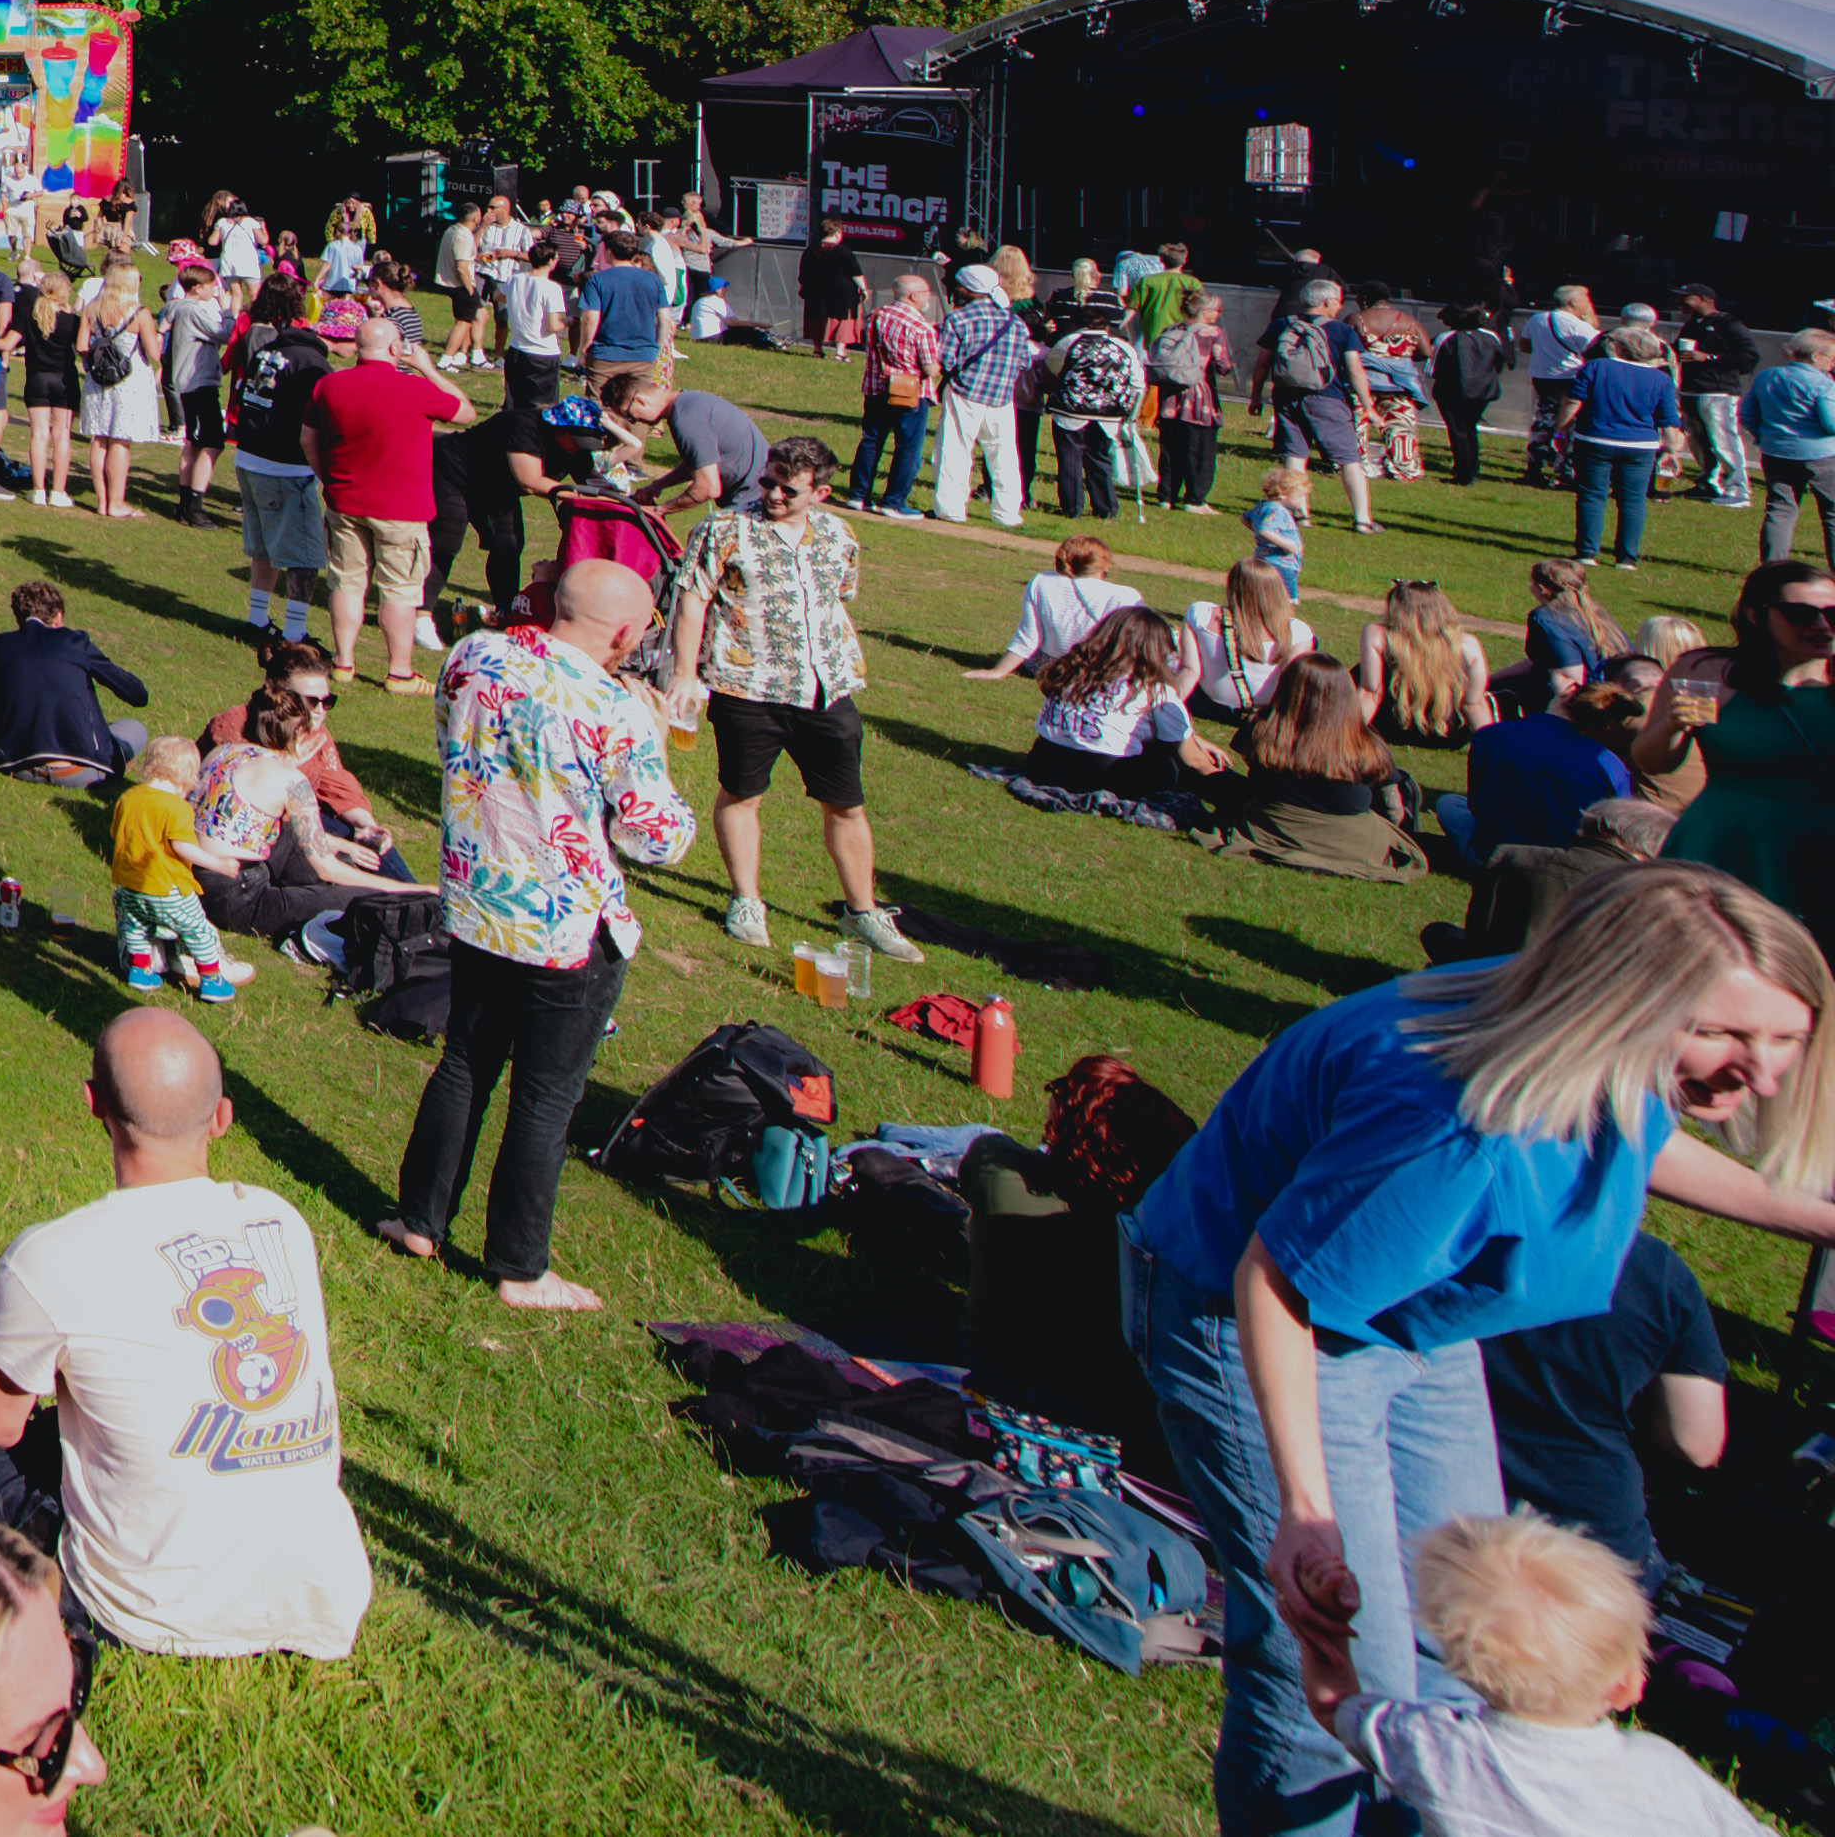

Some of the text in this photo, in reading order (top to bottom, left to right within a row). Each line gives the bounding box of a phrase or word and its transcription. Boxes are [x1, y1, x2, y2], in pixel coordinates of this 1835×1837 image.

[9, 89, 26, 99] UP
[1606, 97, 1835, 149] FRING
[447, 181, 493, 195] TOILETS
[821, 160, 888, 190] THE
[821, 188, 948, 224] FRINGE
[238, 1442, 325, 1468] WATER SPORTS
